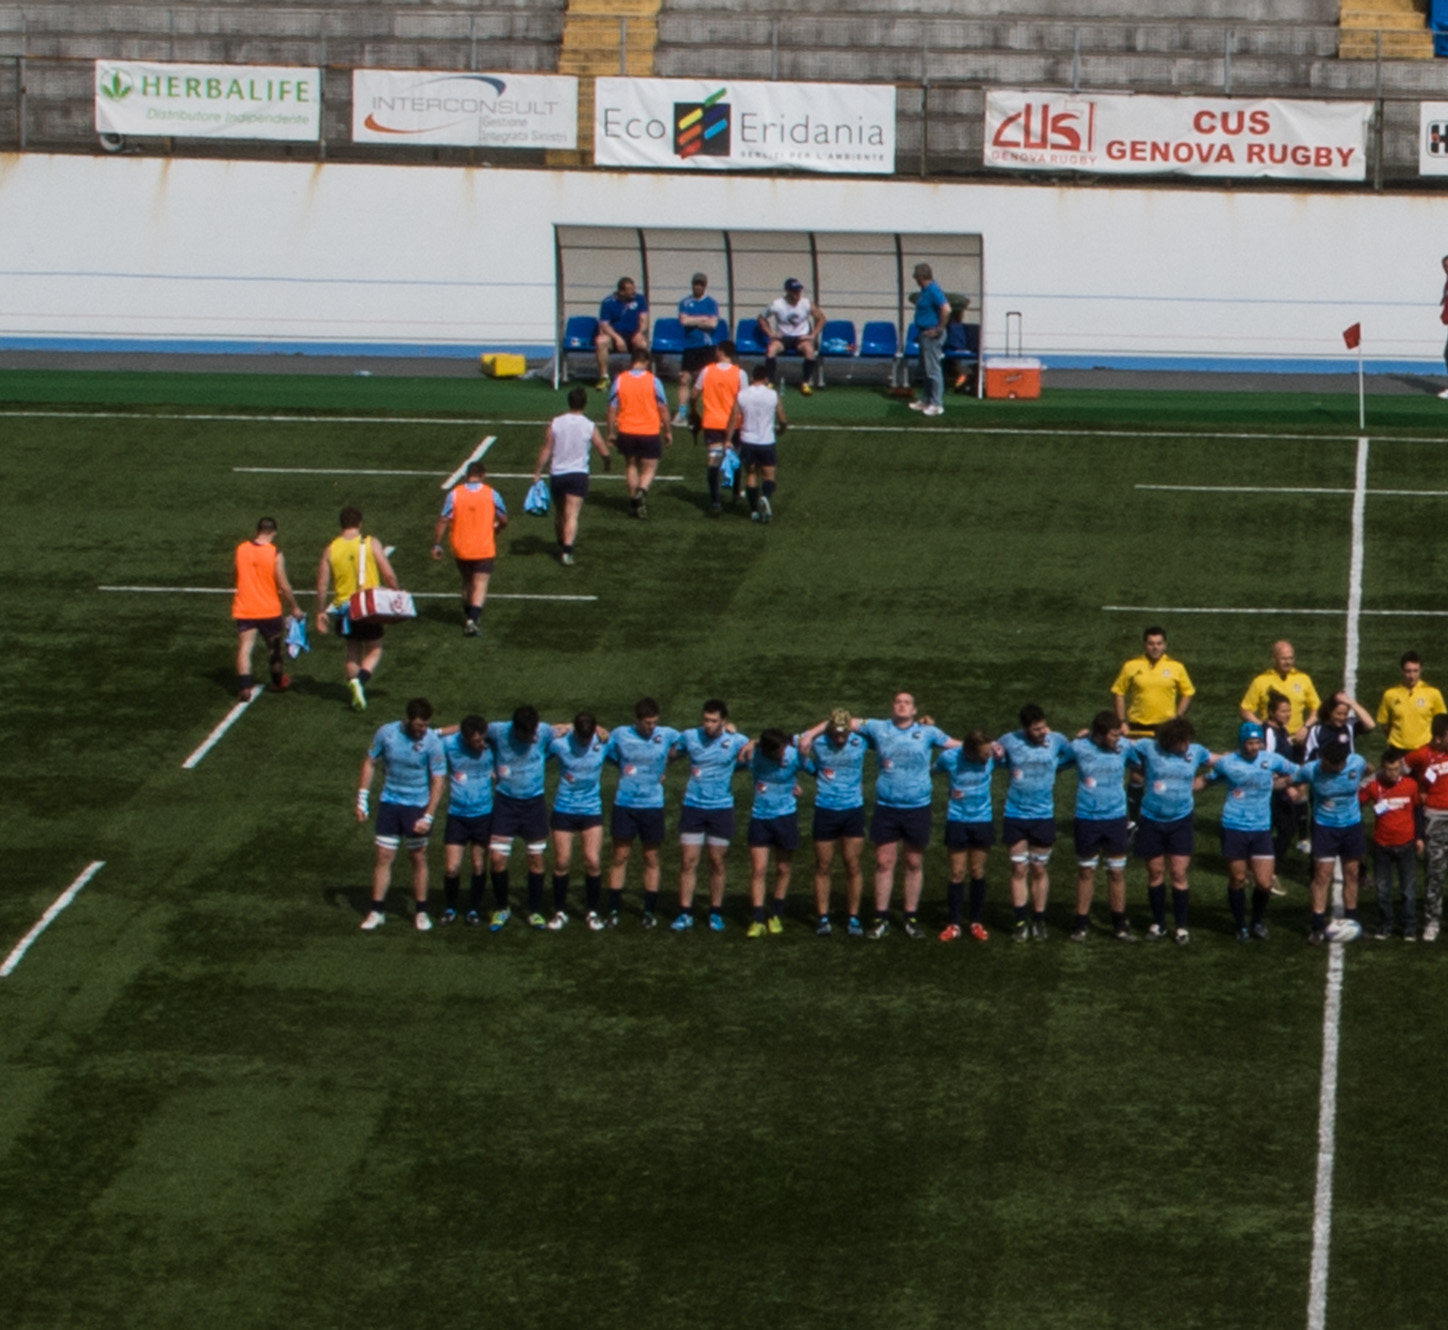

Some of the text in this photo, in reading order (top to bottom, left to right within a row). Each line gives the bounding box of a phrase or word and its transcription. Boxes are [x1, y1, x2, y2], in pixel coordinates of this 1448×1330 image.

[141, 75, 310, 102] HERBALIFE
[146, 108, 310, 125] Distributore Indipendente
[372, 96, 559, 116] INTERCONSULT
[482, 117, 528, 128] Gestione
[604, 108, 666, 140] Eco
[740, 113, 884, 146] Eridania
[1193, 110, 1271, 135] CUS
[788, 152, 811, 161] PER
[991, 150, 1097, 165] GENOVA RUGBY
[1106, 140, 1356, 168] GENOVA RUGBY
